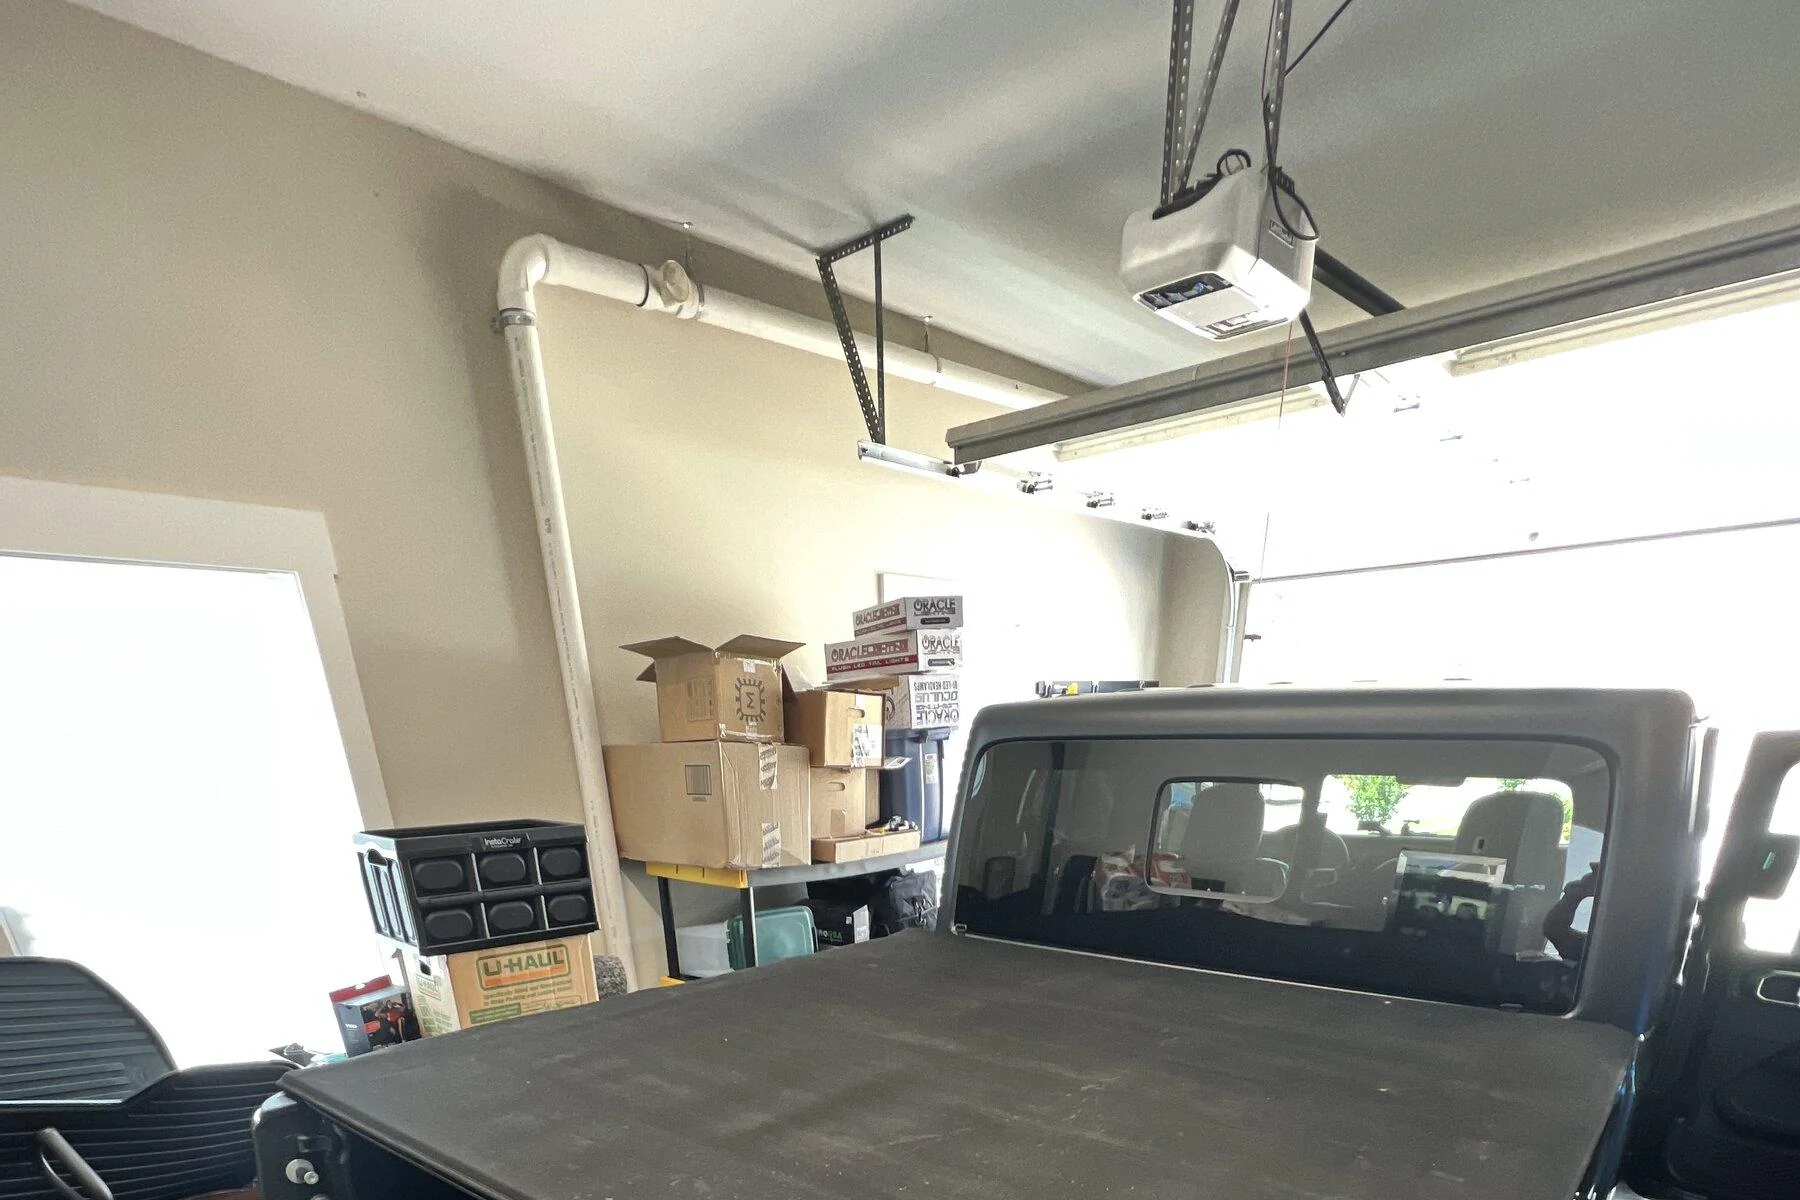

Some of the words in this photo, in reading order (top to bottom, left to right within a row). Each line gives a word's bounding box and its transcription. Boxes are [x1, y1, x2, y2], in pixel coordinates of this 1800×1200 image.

[913, 598, 956, 612] ORACLE
[922, 634, 960, 650] ORACLE
[484, 951, 564, 976] U-HAUL
